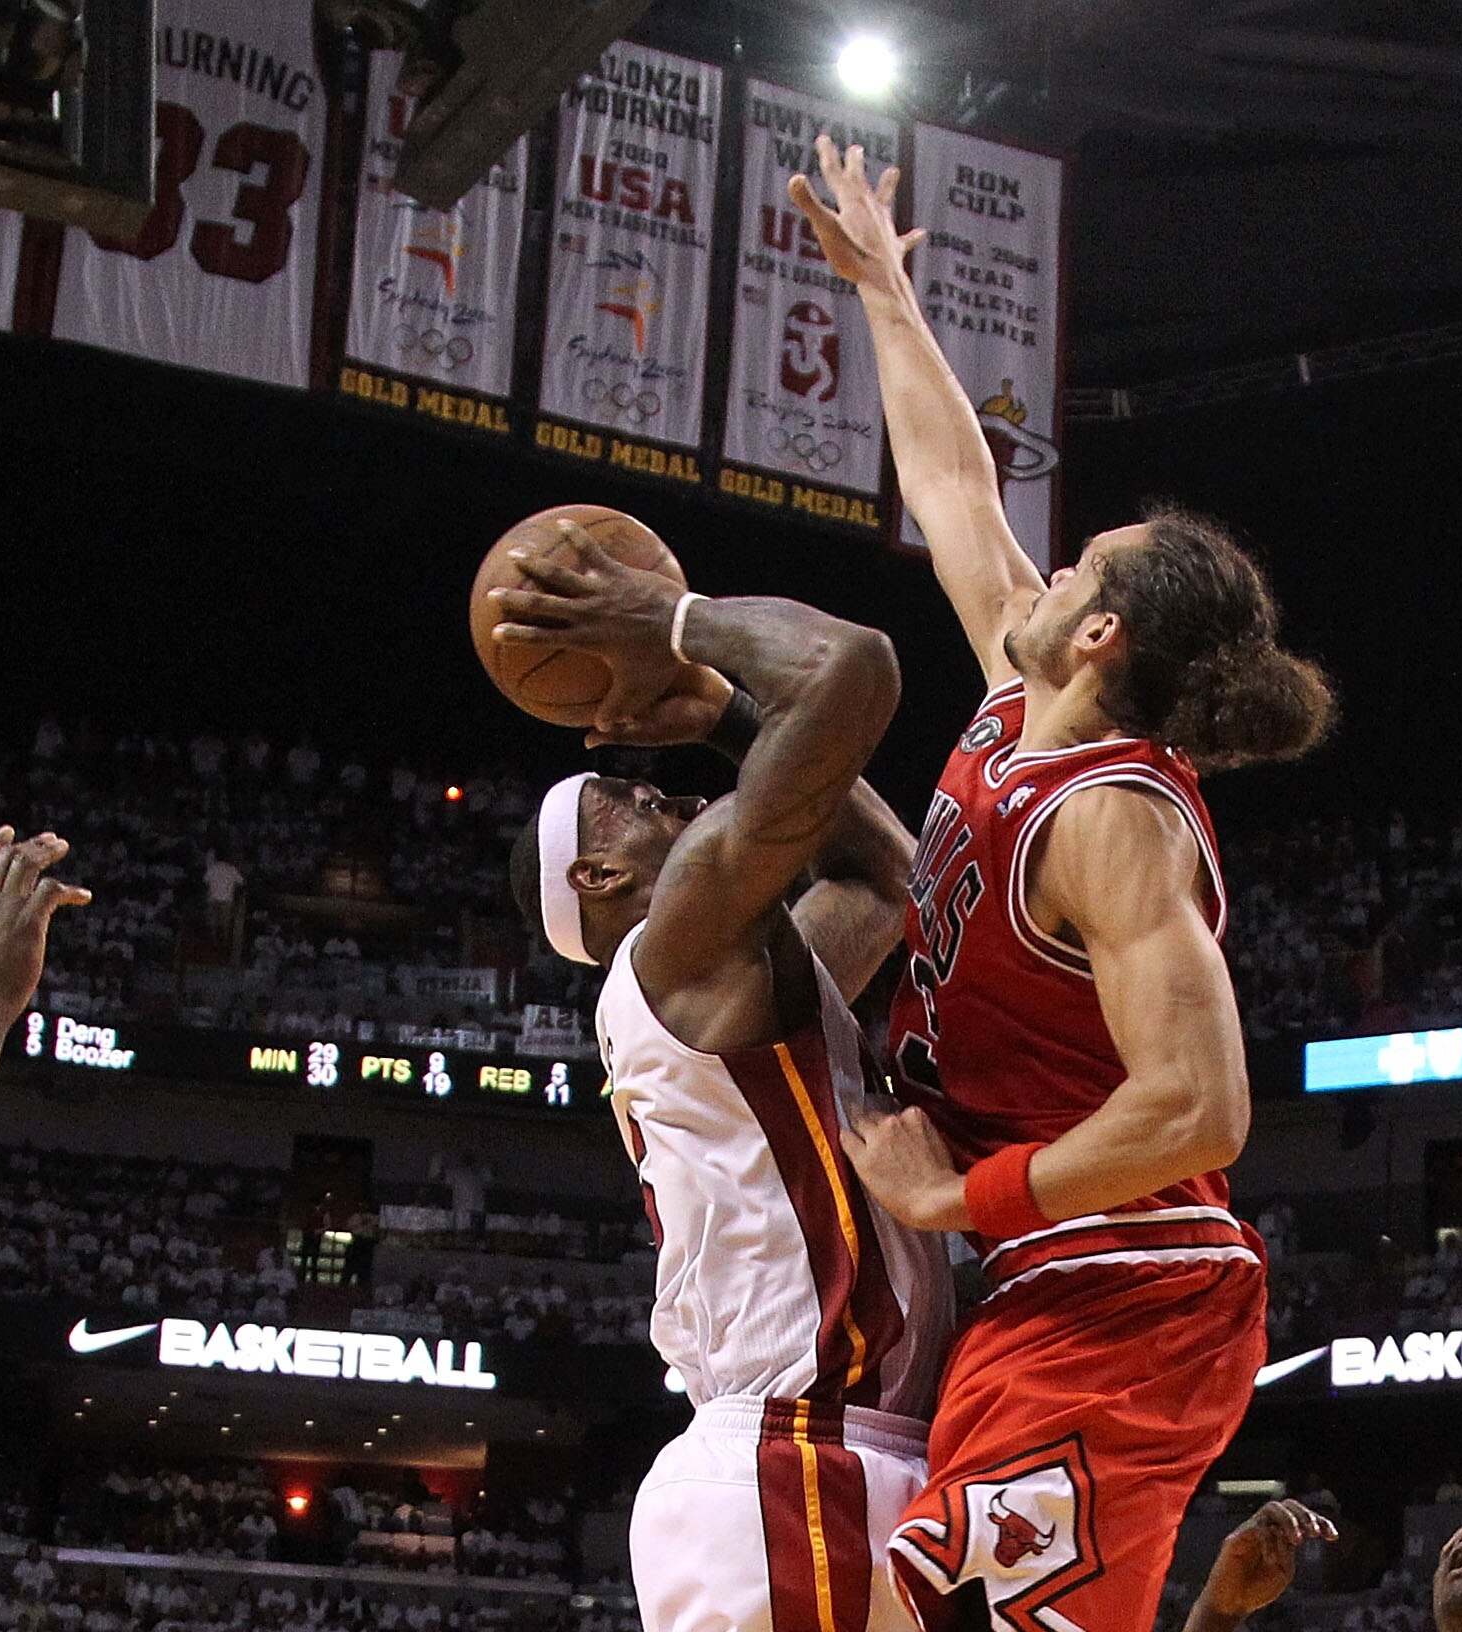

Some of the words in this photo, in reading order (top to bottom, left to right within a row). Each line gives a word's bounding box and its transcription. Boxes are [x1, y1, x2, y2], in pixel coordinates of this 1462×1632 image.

[155, 28, 313, 112] URNING
[605, 54, 701, 107] LONZO
[580, 153, 696, 225] USA
[948, 185, 1025, 222] CULP
[956, 164, 1021, 200] RON
[926, 279, 1038, 324] ATHLETIC
[341, 367, 409, 409] GOLD
[416, 387, 510, 433] MEDAL
[536, 420, 603, 459] GOLD
[610, 439, 702, 483] MEDAL
[720, 468, 785, 505] GOLD
[792, 487, 880, 528] MEDAL
[55, 1015, 117, 1051] Deng
[55, 1039, 137, 1070] Boozer
[250, 1046, 298, 1073] MIN
[307, 1041, 339, 1064] 29
[361, 1055, 413, 1083] PTS
[479, 1065, 532, 1093] REB
[306, 1063, 338, 1087] 30
[423, 1071, 453, 1097] 19
[545, 1083, 572, 1108] 11
[158, 1317, 496, 1390] BASKETBALL
